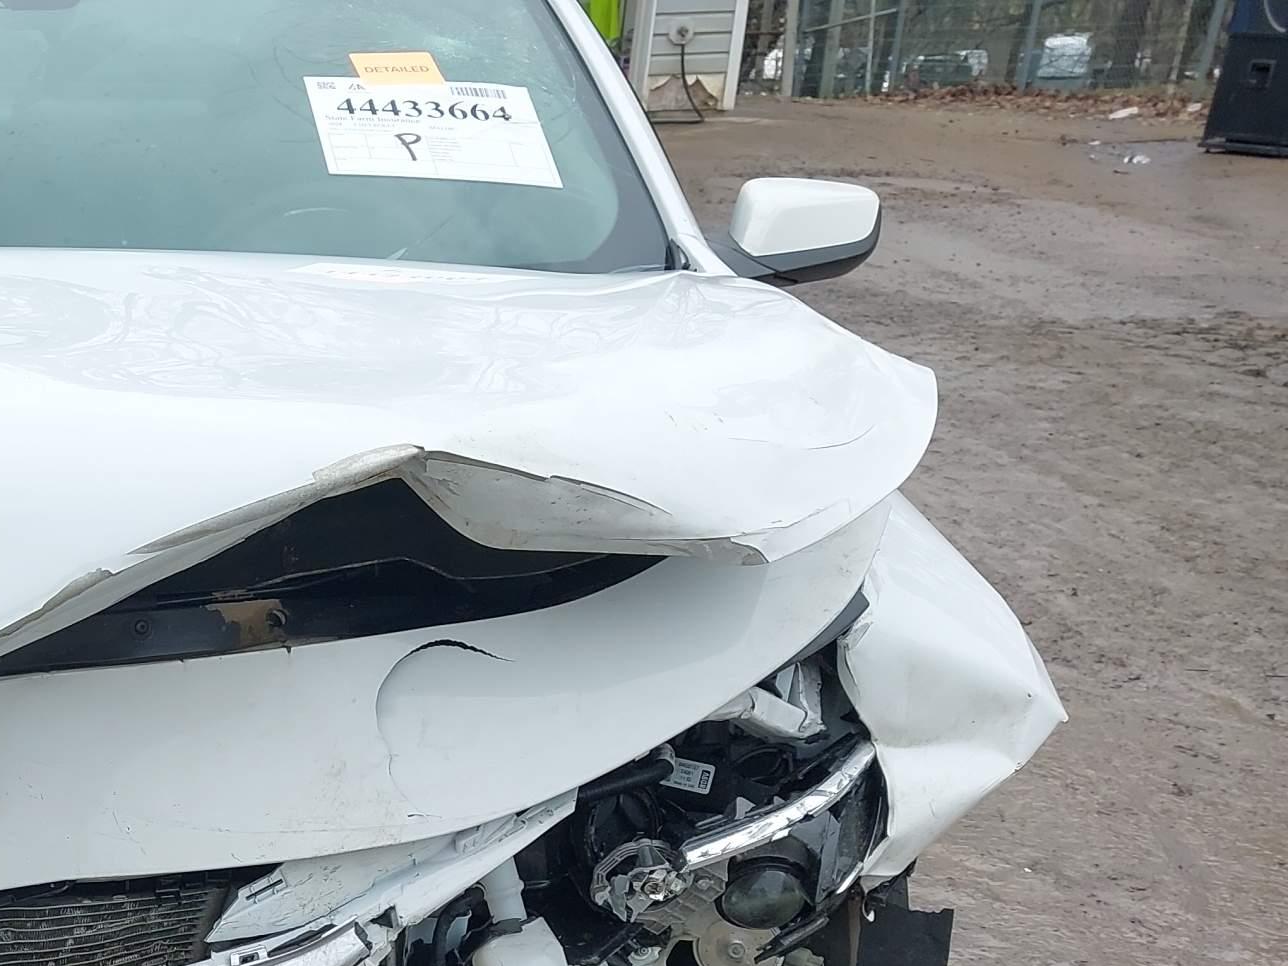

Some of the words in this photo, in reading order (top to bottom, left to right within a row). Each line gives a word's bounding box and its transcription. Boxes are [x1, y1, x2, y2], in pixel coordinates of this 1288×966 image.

[364, 65, 430, 73] DETAILED
[337, 98, 511, 121] 44433664
[394, 132, 422, 162] P
